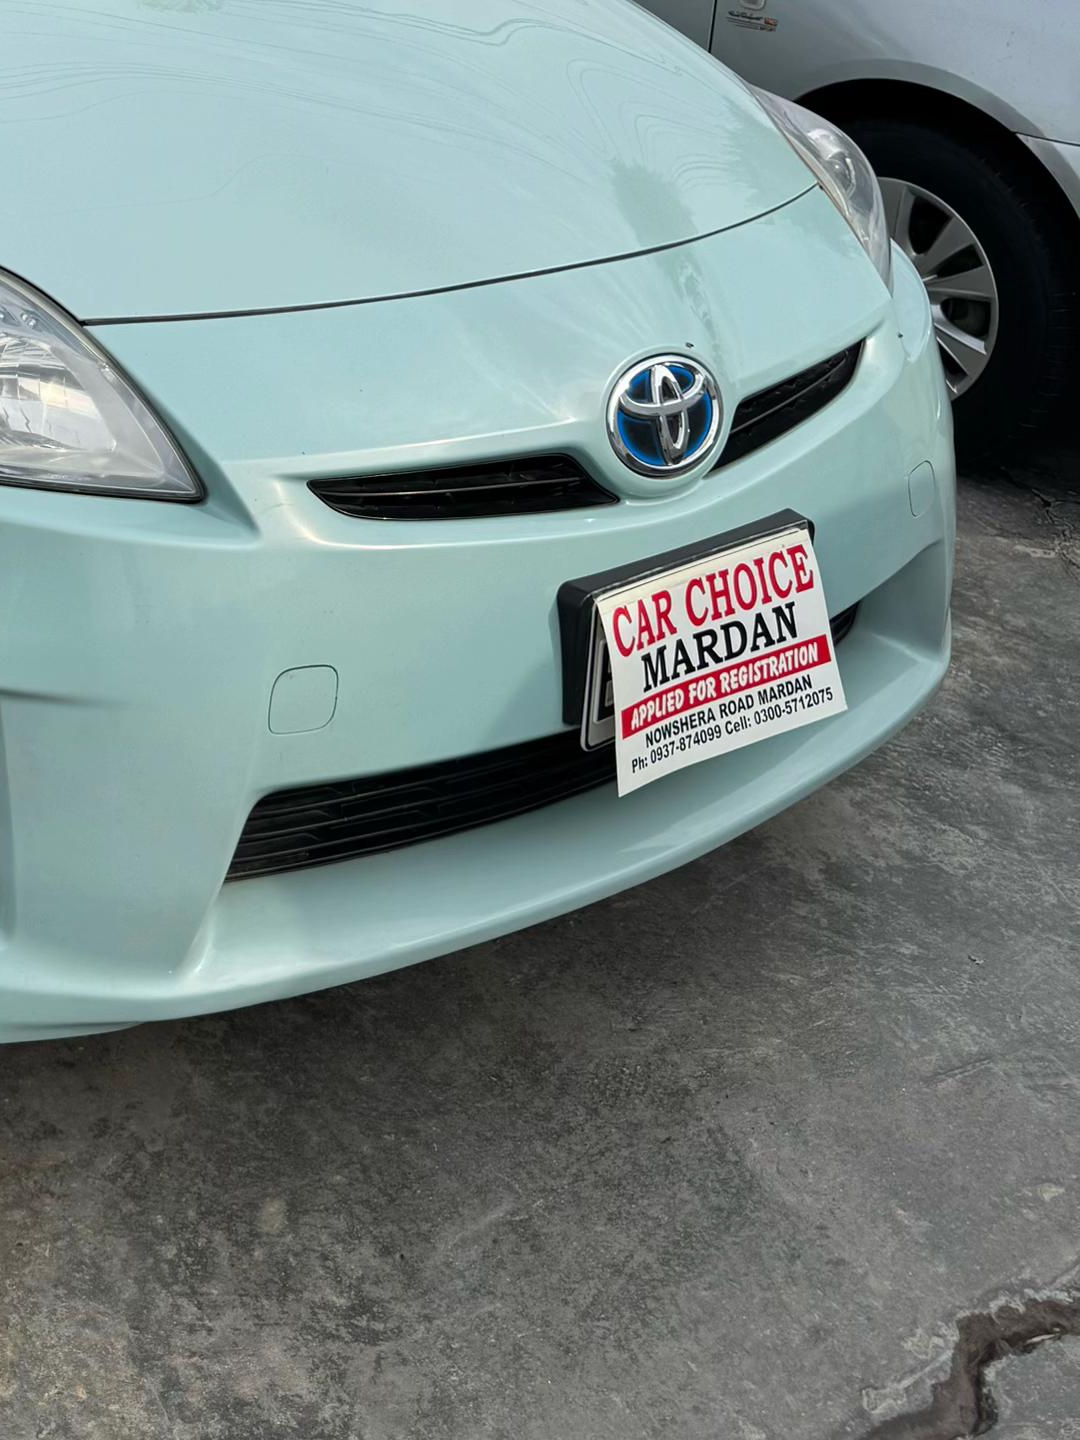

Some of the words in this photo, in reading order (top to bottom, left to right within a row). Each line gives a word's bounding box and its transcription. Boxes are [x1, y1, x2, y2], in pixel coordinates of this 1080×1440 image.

[612, 589, 677, 657] CAR
[685, 544, 814, 627] CHOICE
[630, 689, 685, 731] APPLIED
[688, 677, 717, 705] FOR
[719, 641, 818, 693] REGISTRATION
[642, 601, 798, 693] MARDAN
[632, 754, 648, 774] Ph:
[650, 729, 722, 765] 0937-874099
[725, 715, 752, 736] Cell:
[754, 687, 833, 726] 0300-5712075
[645, 707, 716, 748] NOWSHERA
[720, 694, 754, 719] ROAD
[758, 674, 812, 705] MARDAN
